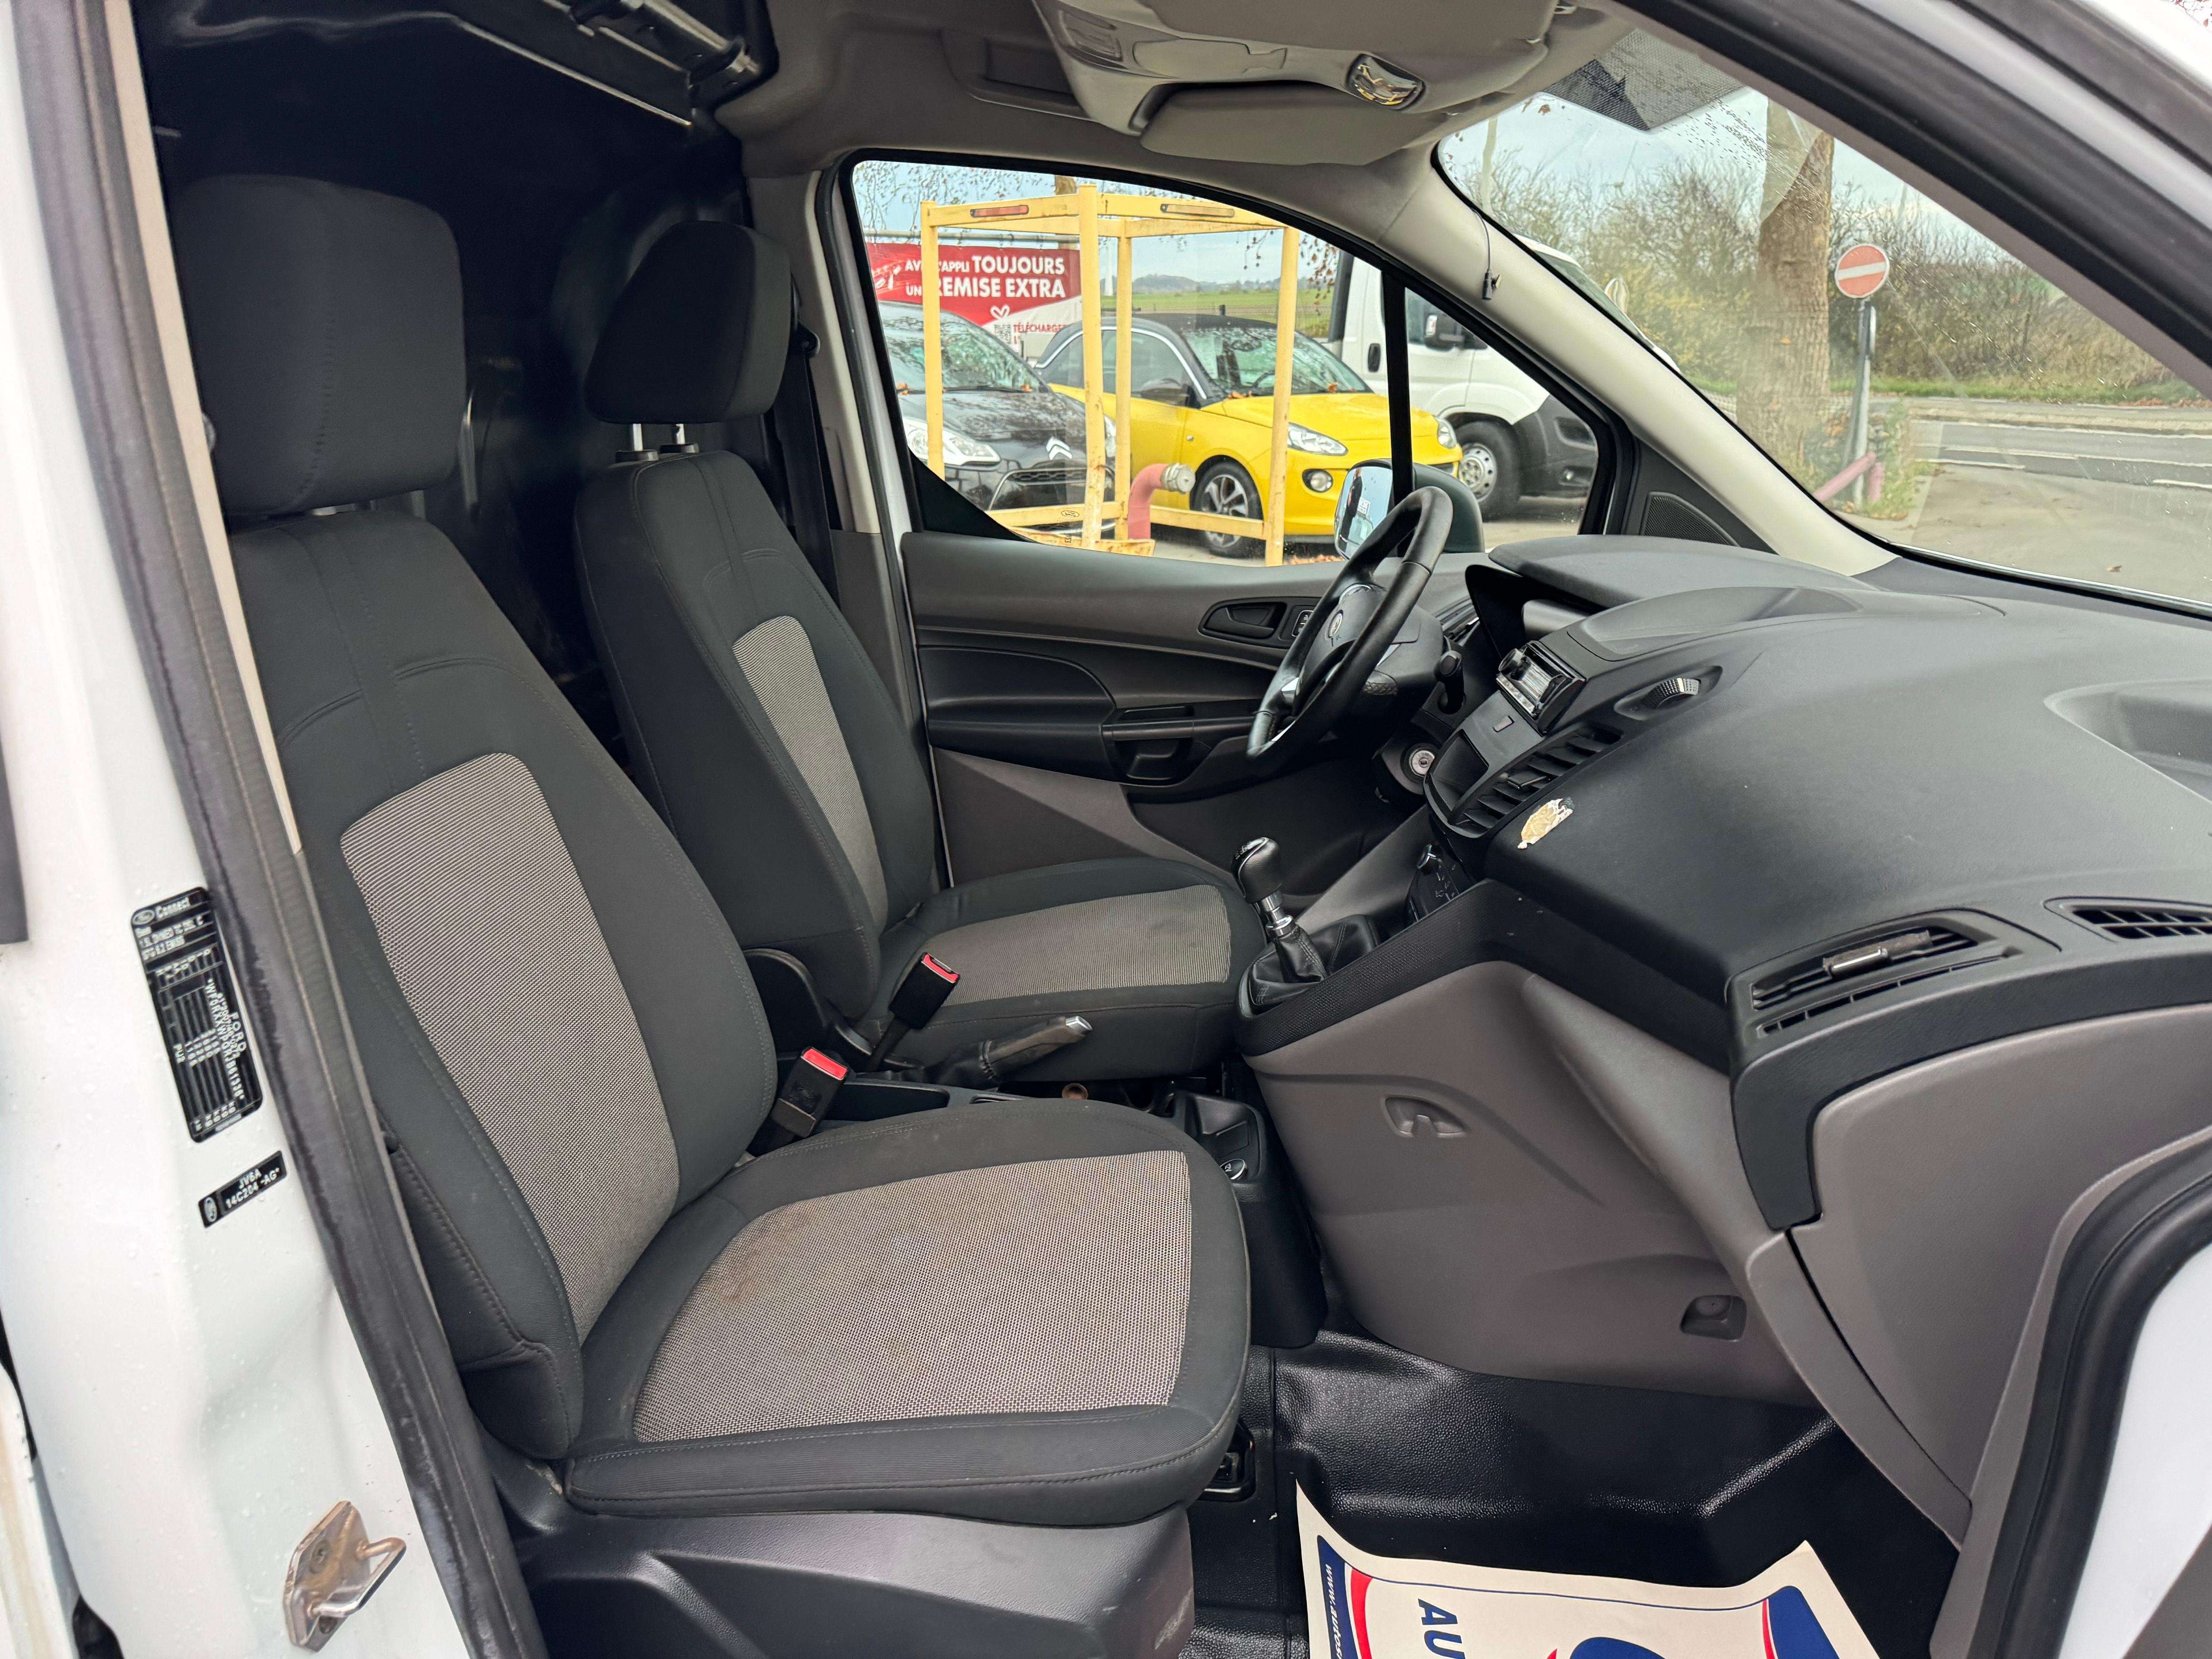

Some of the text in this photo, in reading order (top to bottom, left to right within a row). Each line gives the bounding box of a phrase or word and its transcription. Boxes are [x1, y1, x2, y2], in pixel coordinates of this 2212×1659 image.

[972, 255, 1065, 275] TOUJOURS
[906, 285, 922, 296] UN
[1006, 278, 1066, 298] EXTRA
[1013, 322, 1067, 333] TÉLÉCHARGE
[229, 1011, 247, 1052] FORD
[1418, 1599, 1465, 1659] AU
